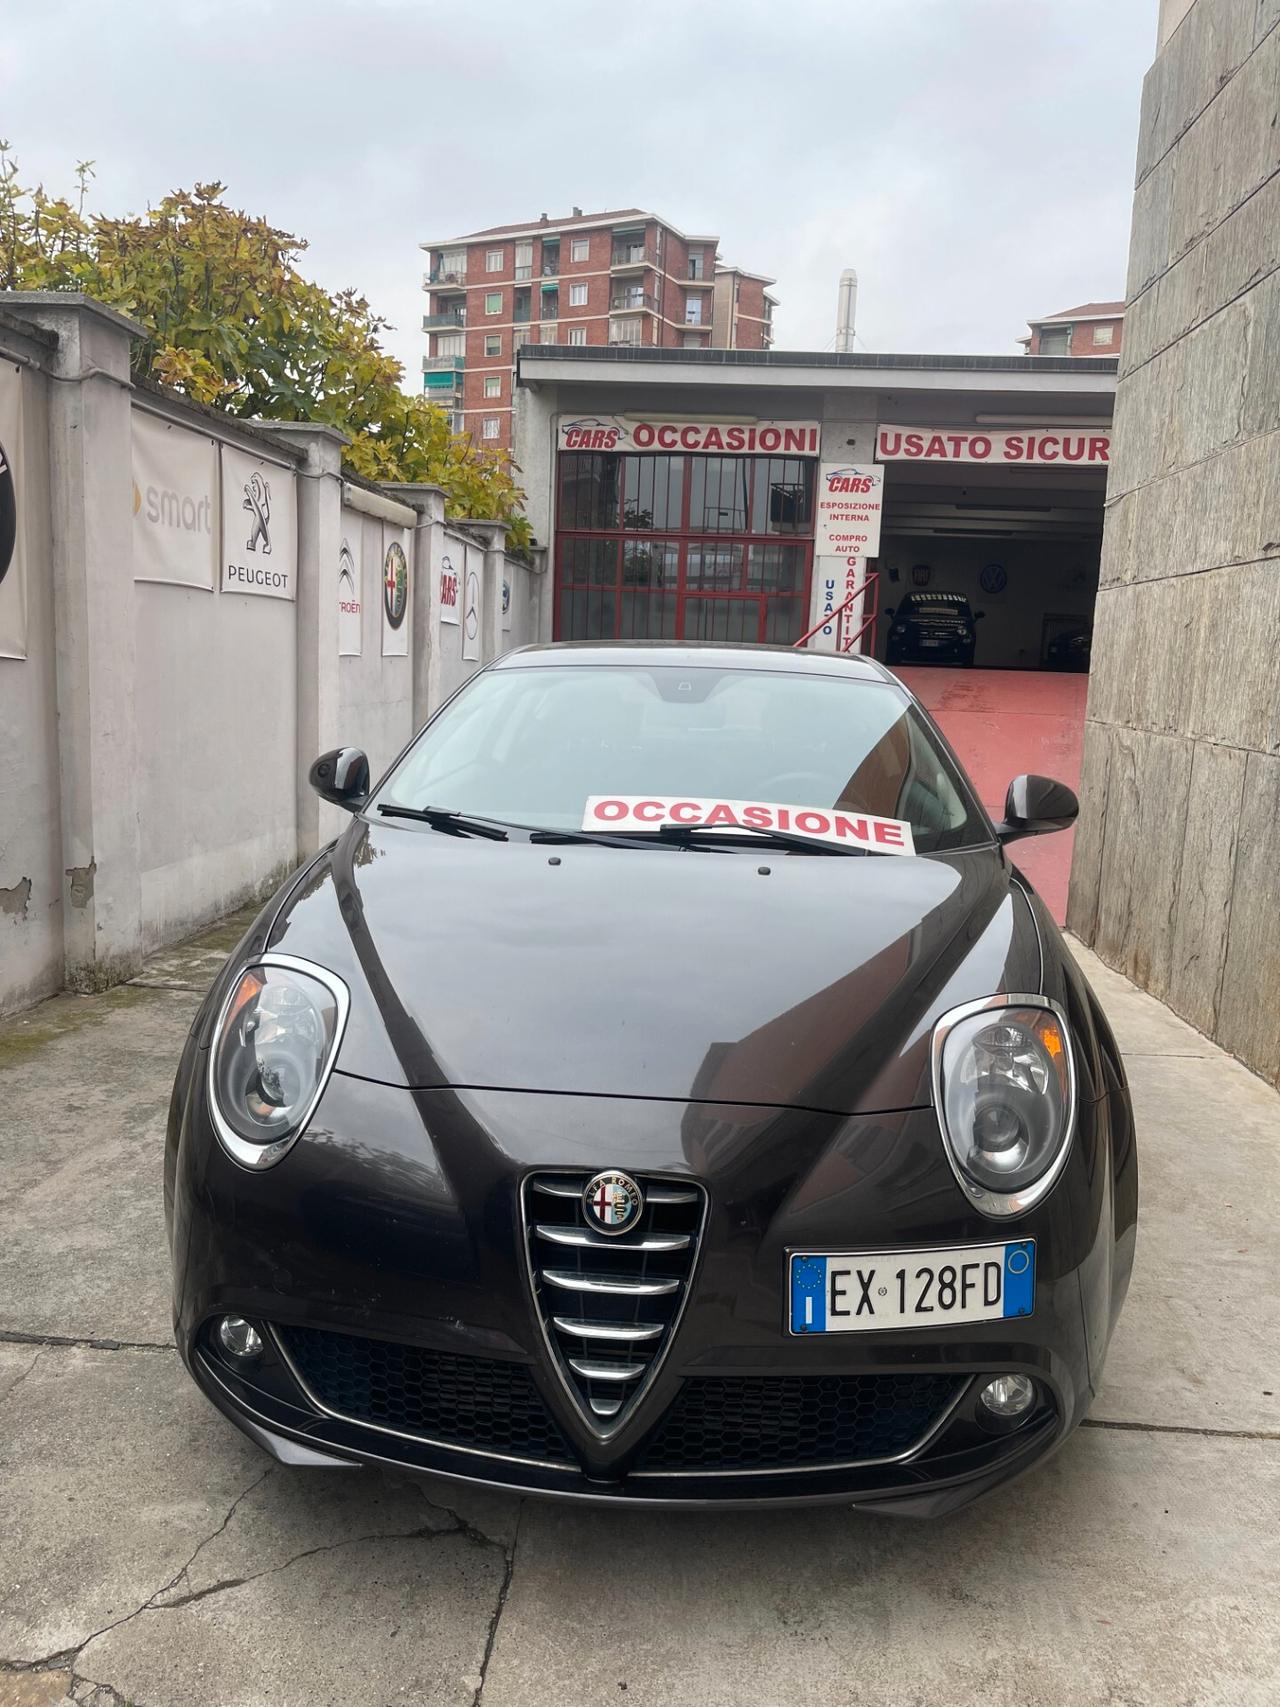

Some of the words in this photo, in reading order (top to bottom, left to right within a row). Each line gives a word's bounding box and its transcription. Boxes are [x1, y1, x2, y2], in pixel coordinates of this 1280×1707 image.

[565, 428, 618, 449] CARS
[633, 424, 817, 452] OCCASIONI
[879, 432, 992, 459] USATO
[828, 477, 872, 494] CARS
[146, 485, 212, 535] smart
[820, 502, 881, 511] ESPOSIZIONE
[829, 513, 870, 522] INTERNA
[828, 534, 868, 543] COMPRO
[835, 545, 860, 553] AUTO
[228, 565, 289, 589] PEUGEOT
[593, 800, 905, 846] OCCASIONE
[587, 1179, 606, 1204] ALFA
[611, 1176, 638, 1206] ROMEO
[830, 1269, 876, 1316] EX
[895, 1261, 1002, 1314] 128FD
